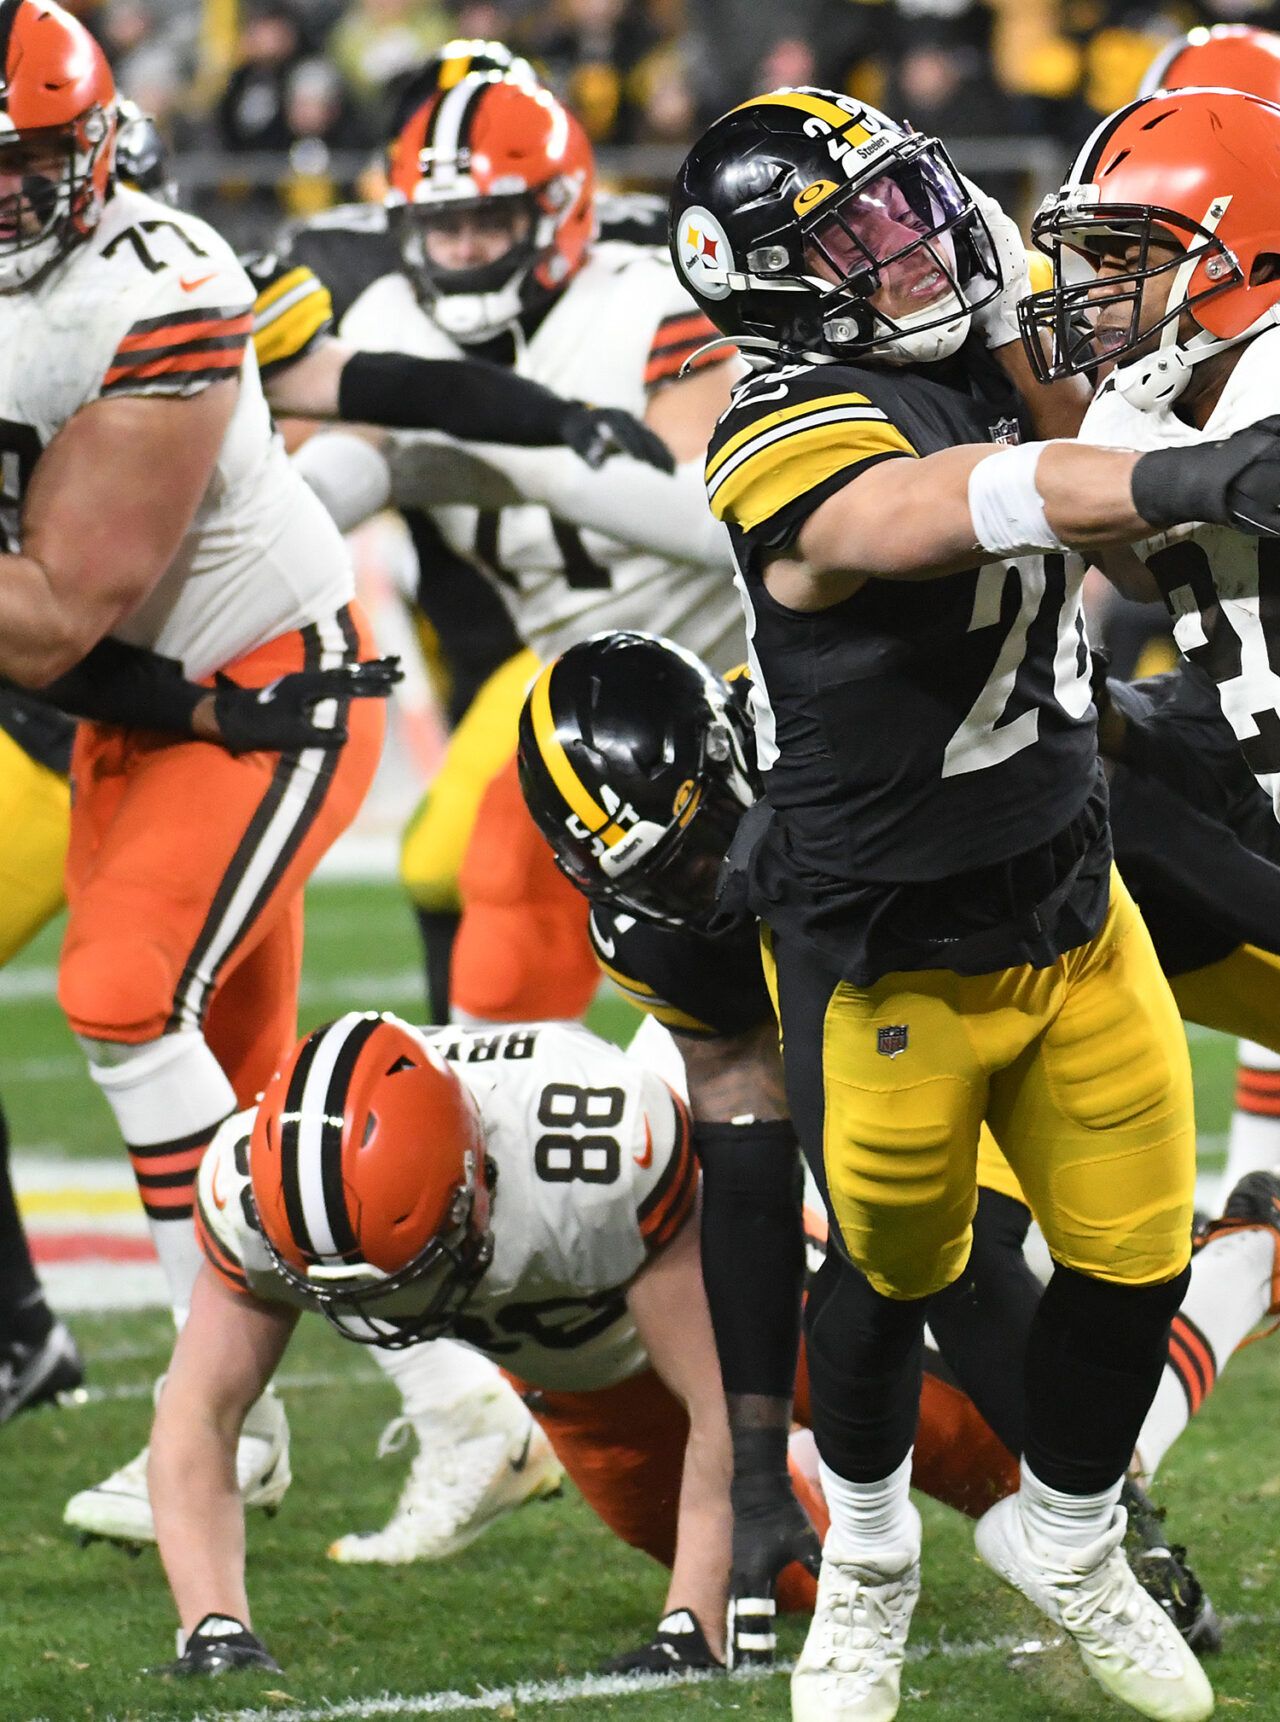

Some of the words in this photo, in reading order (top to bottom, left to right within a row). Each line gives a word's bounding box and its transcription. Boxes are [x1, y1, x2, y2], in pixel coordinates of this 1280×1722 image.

[856, 136, 890, 159] Steelers
[100, 220, 208, 273] 77
[535, 1082, 627, 1186] 88
